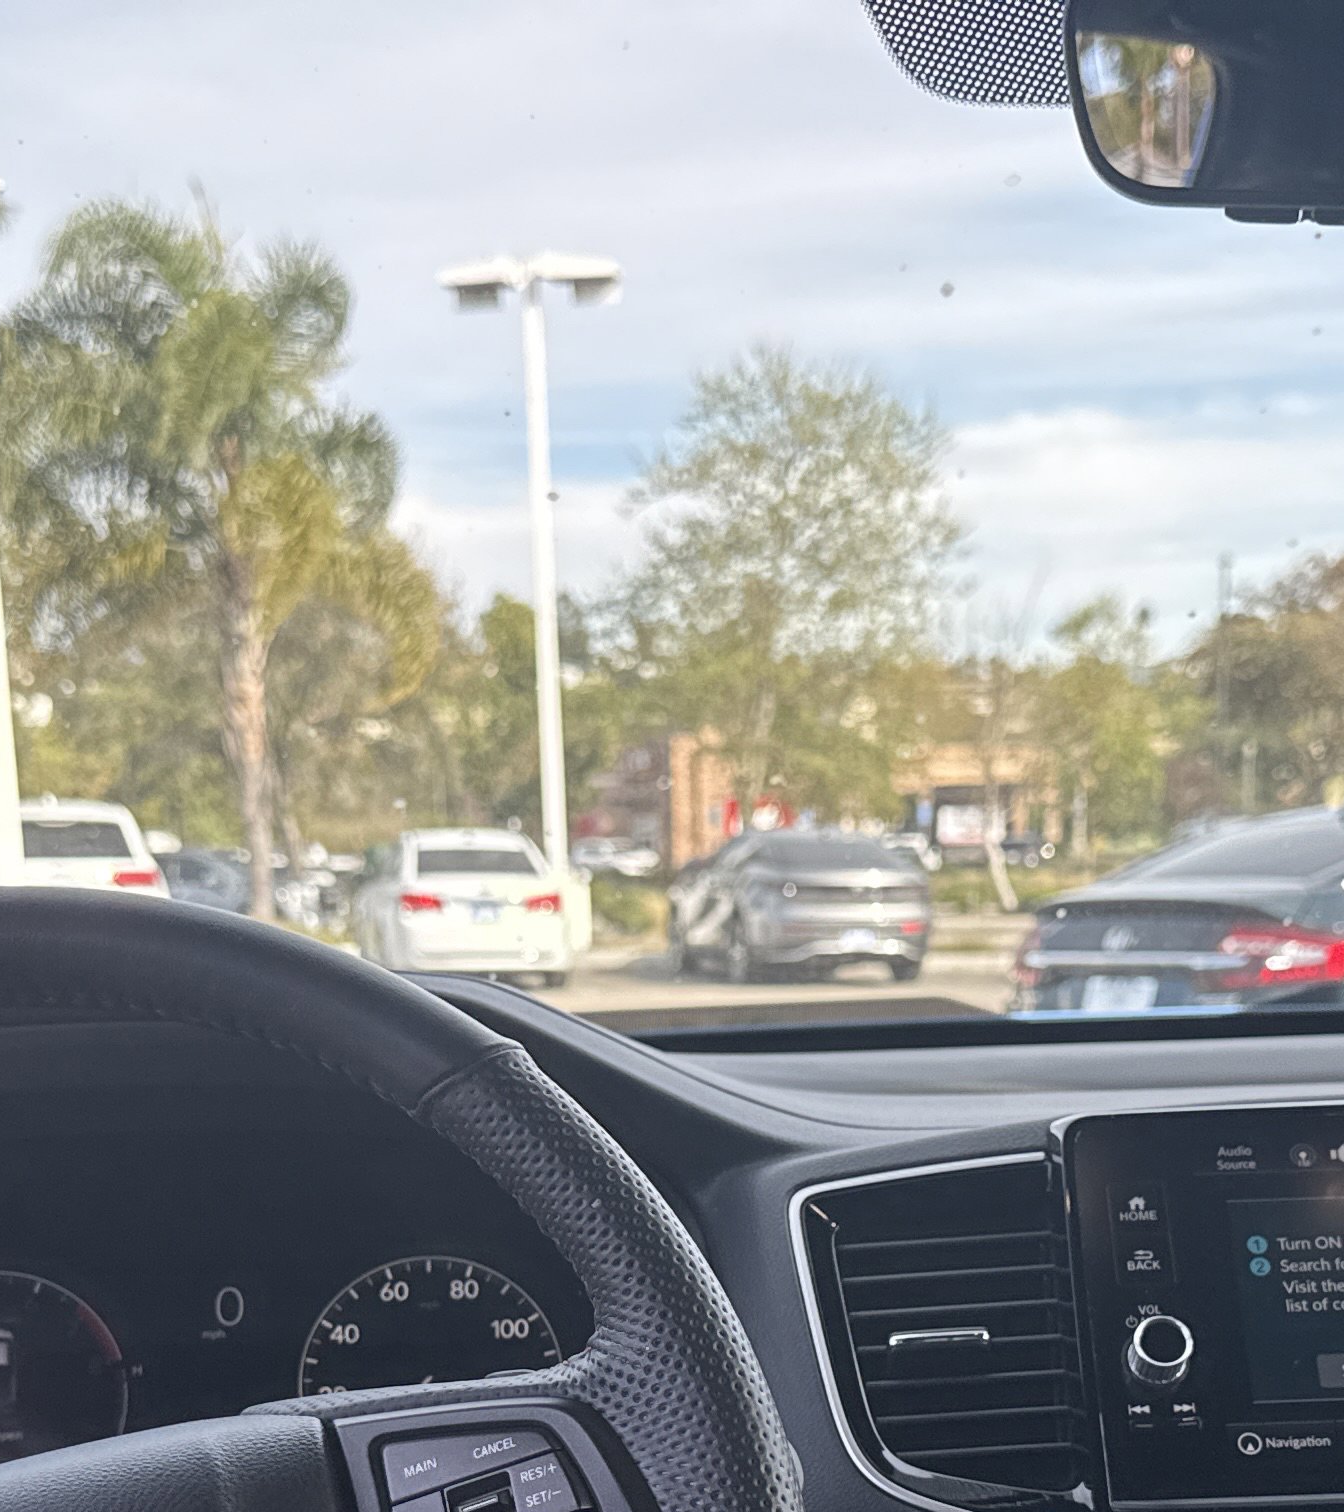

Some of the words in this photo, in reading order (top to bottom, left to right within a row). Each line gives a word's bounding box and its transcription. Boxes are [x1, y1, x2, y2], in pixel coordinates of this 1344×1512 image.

[1217, 1146, 1252, 1157] Audio
[1216, 1159, 1256, 1170] Source
[1119, 1210, 1157, 1222] HOME
[1276, 1236, 1312, 1251] Turn
[1314, 1235, 1343, 1251] ON
[1127, 1259, 1161, 1271] BACK
[1280, 1257, 1328, 1273] Search
[379, 1281, 409, 1302] 60
[450, 1279, 479, 1300] 80
[1282, 1279, 1317, 1294] Visit
[215, 1286, 244, 1327] 0
[1138, 1304, 1162, 1315] VOL
[1285, 1299, 1310, 1313] list
[1312, 1297, 1330, 1312] of
[329, 1323, 360, 1344] 40
[490, 1317, 530, 1340] 100
[472, 1436, 517, 1460] CANCEL
[1265, 1434, 1331, 1450] Navigation
[403, 1457, 438, 1478] MAIN
